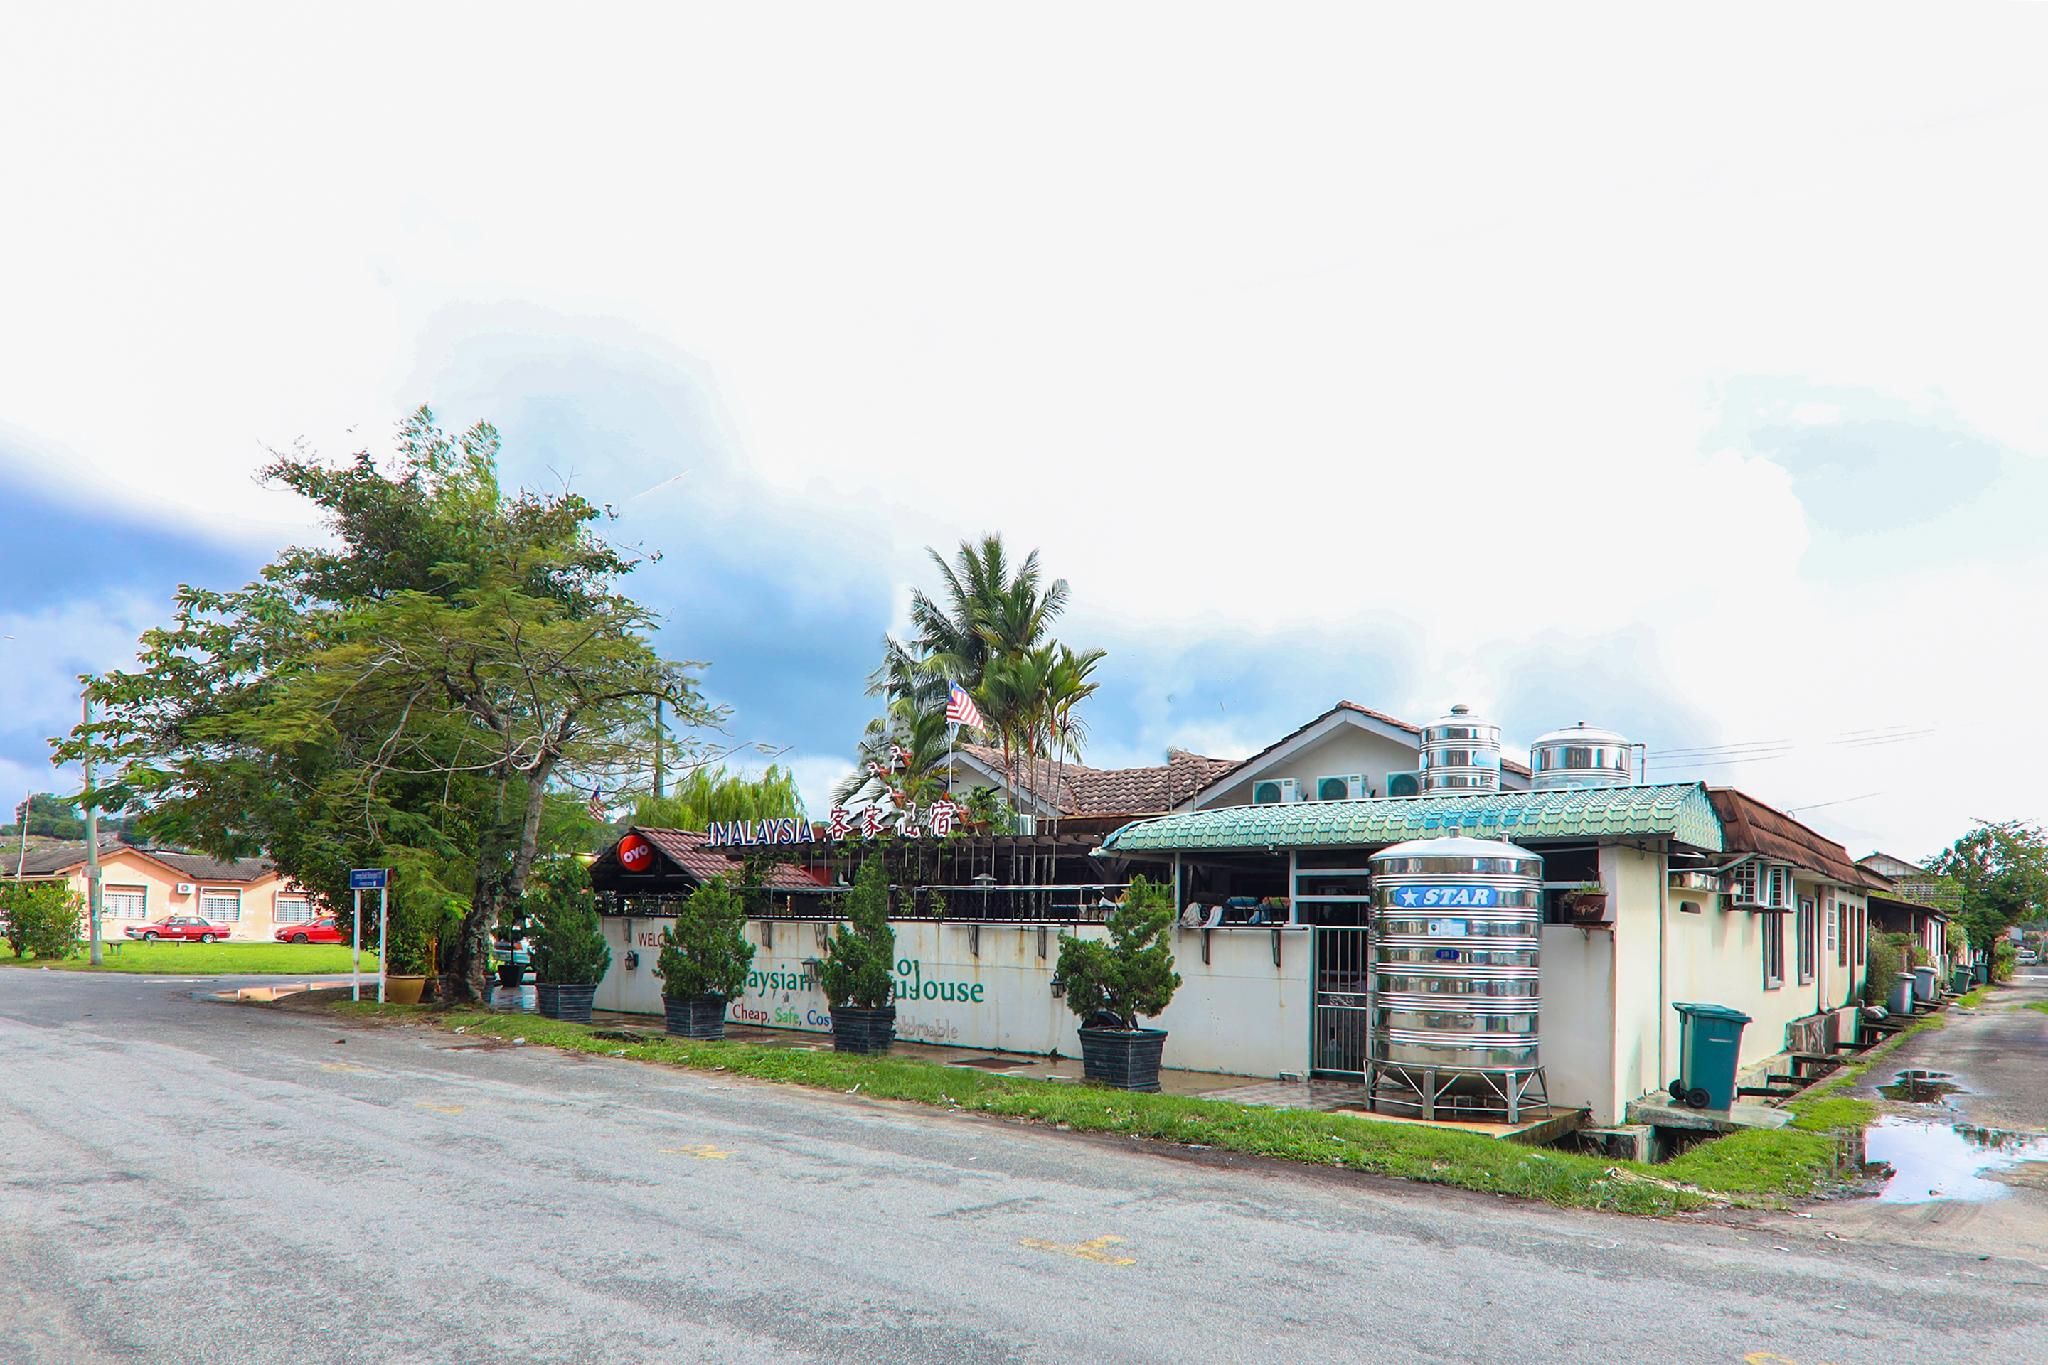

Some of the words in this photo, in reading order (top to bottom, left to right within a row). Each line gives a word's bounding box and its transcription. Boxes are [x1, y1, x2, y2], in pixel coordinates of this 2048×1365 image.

[705, 817, 815, 847] 1MALAYSIA
[623, 844, 649, 863] OYO
[1423, 888, 1489, 905] STAR
[638, 932, 665, 948] WELC
[743, 964, 812, 997] aysian
[732, 1004, 770, 1025] Cheap,
[774, 1006, 801, 1026] Safe,
